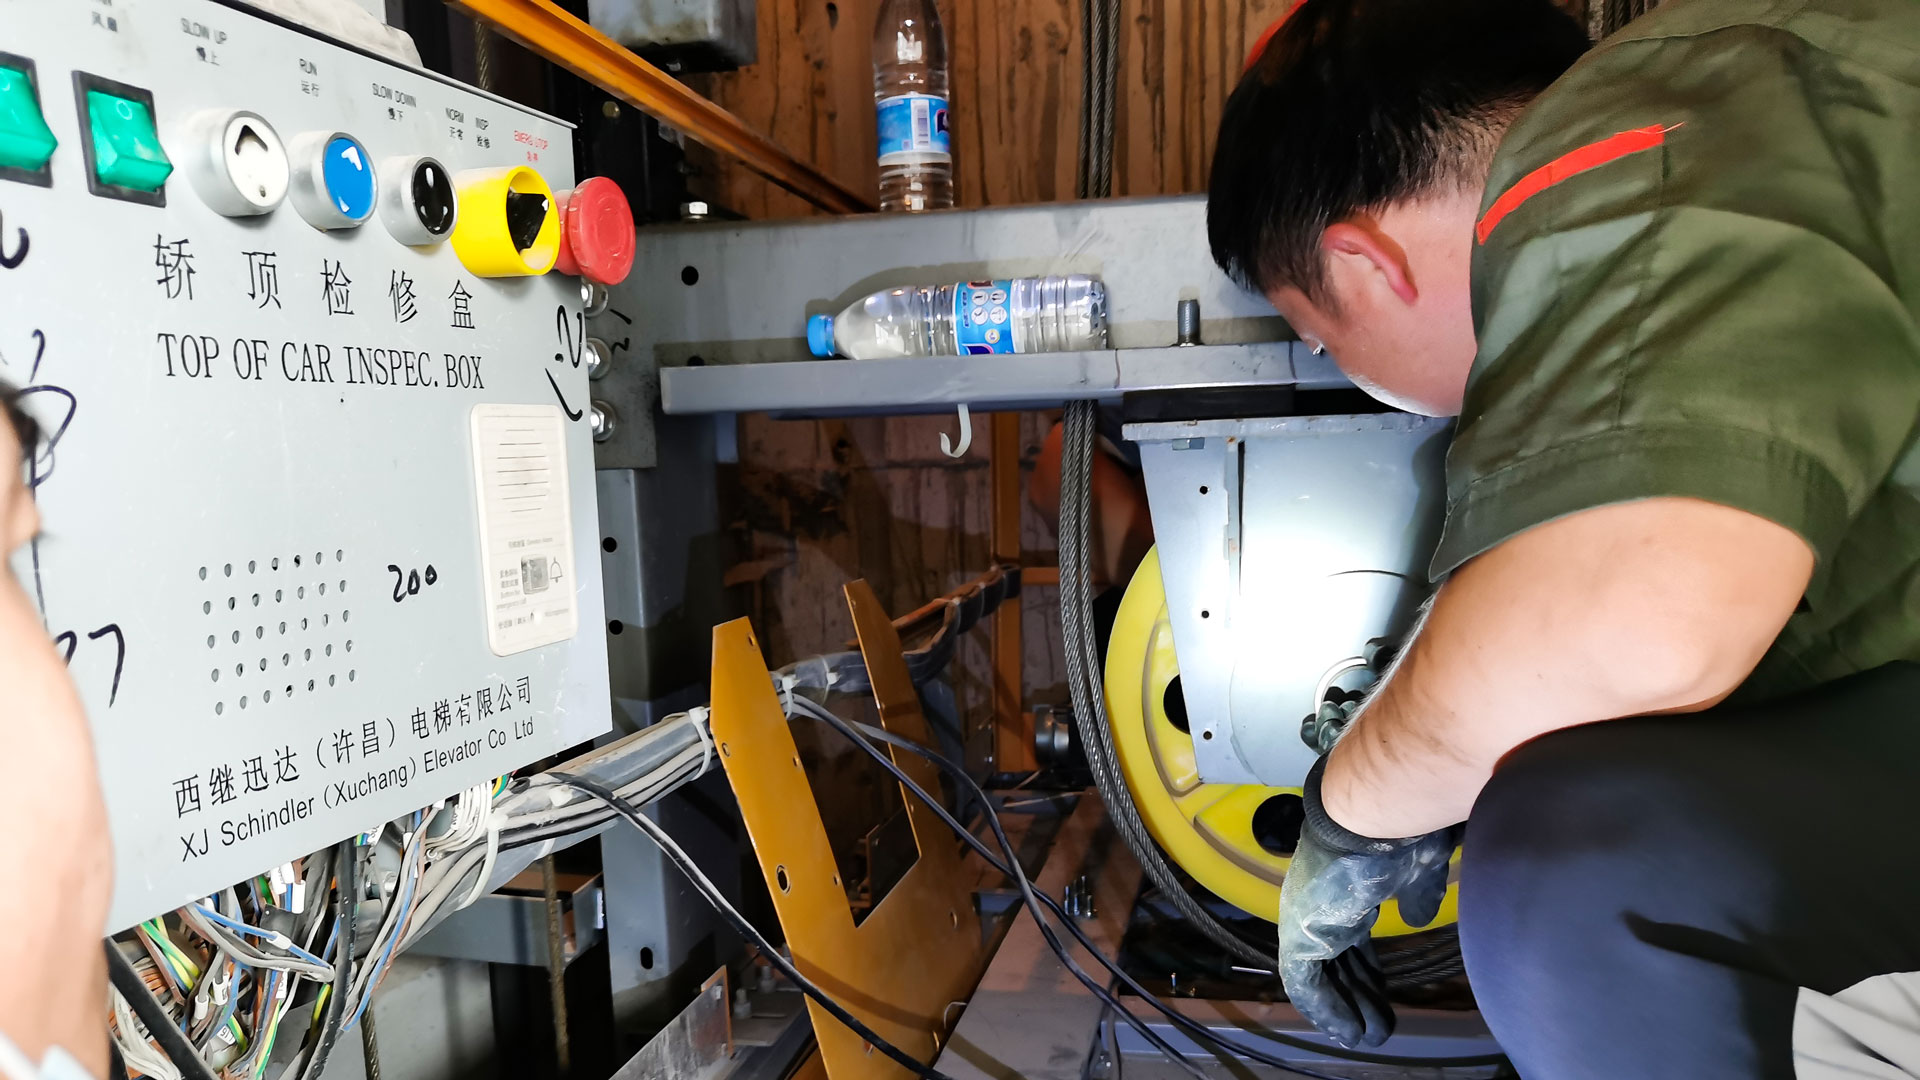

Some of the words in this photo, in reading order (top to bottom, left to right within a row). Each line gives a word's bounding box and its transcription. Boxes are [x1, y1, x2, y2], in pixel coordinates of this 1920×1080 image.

[299, 58, 317, 76] RUN
[372, 82, 393, 100] SLOW
[394, 90, 416, 108] DOWN
[153, 233, 476, 330] 轿顶检修盒
[157, 332, 220, 378] TOP
[232, 337, 270, 381] OF
[280, 341, 335, 383] CAR
[342, 345, 439, 388] INSPEC.
[444, 353, 485, 389] BOX
[387, 563, 438, 603] 200
[181, 827, 210, 863] XJ
[220, 795, 315, 848] Schindler
[423, 736, 483, 774] Elevator
[487, 728, 507, 749] Co
[514, 716, 535, 738] Ltd
